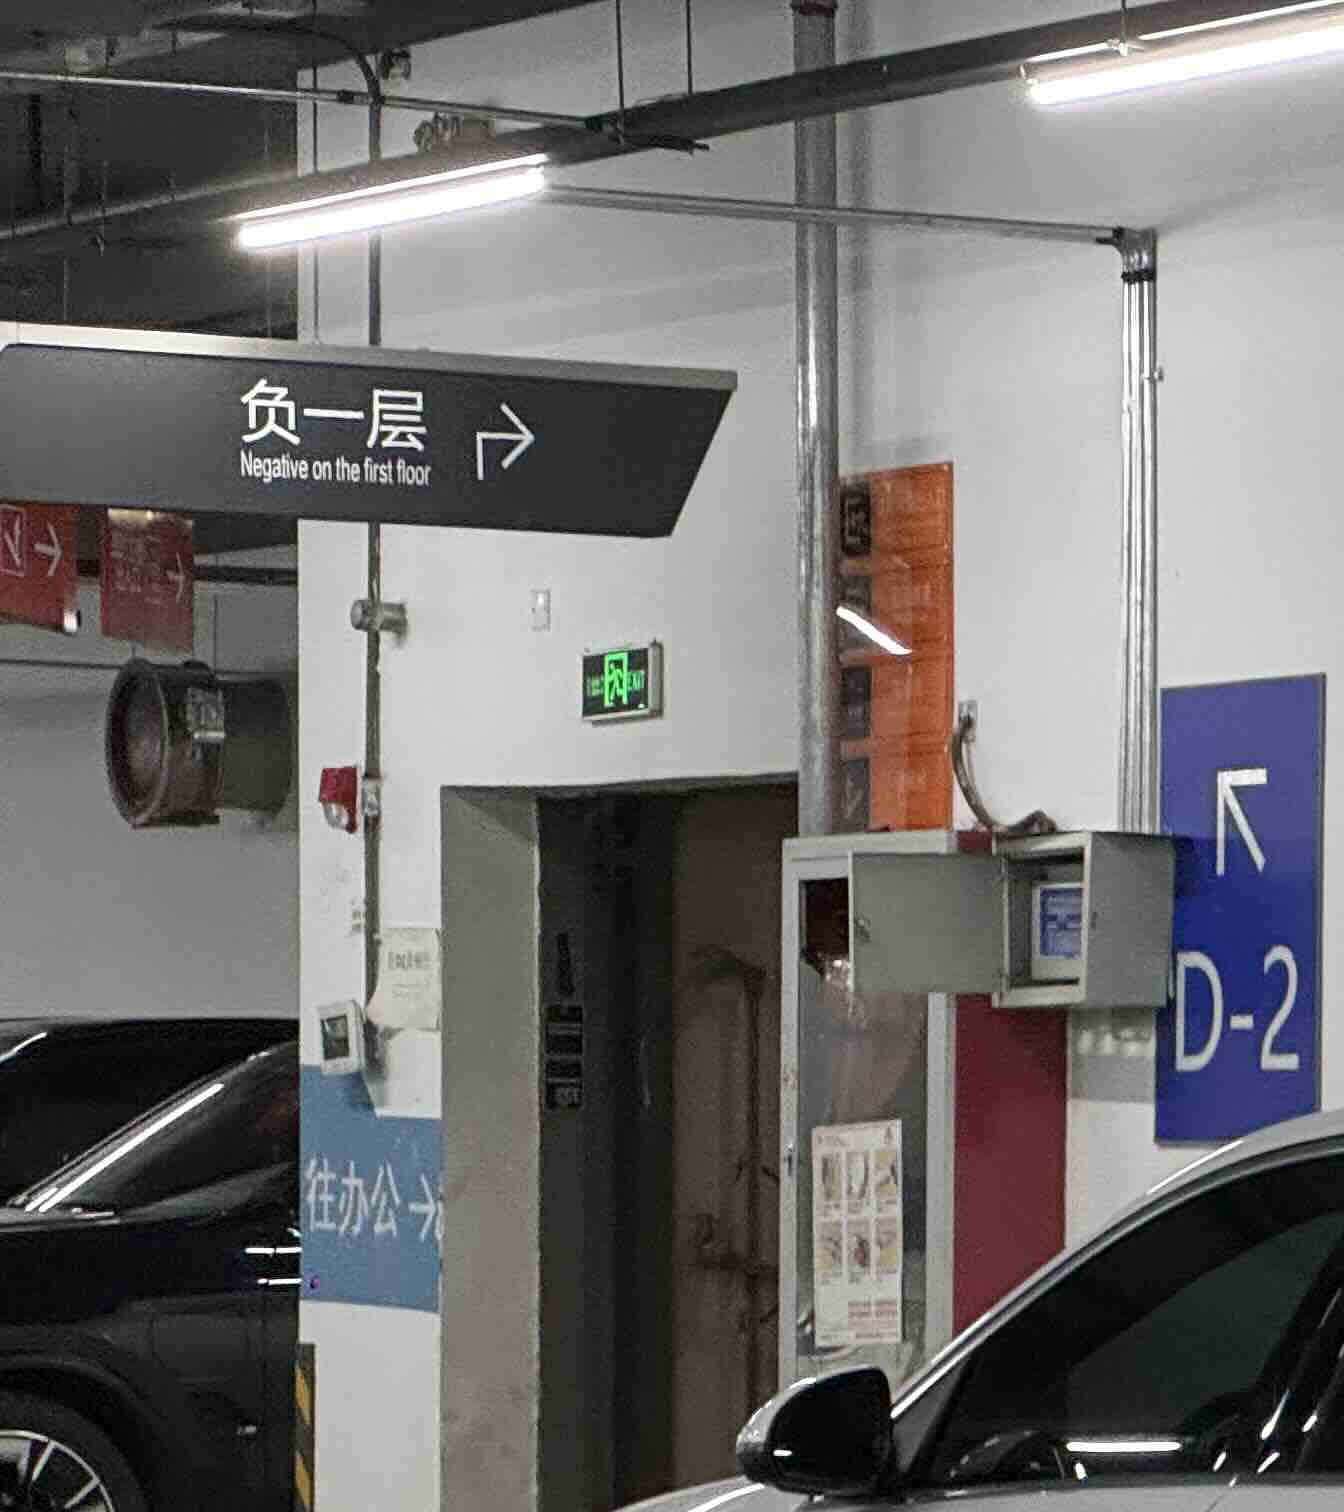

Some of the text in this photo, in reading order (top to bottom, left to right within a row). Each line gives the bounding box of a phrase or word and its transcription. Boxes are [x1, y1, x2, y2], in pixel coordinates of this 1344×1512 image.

[240, 378, 428, 452] 负一层
[240, 450, 432, 486] Negative on the first floor
[1175, 944, 1300, 1072] D-2
[305, 1157, 401, 1238] 往办公
